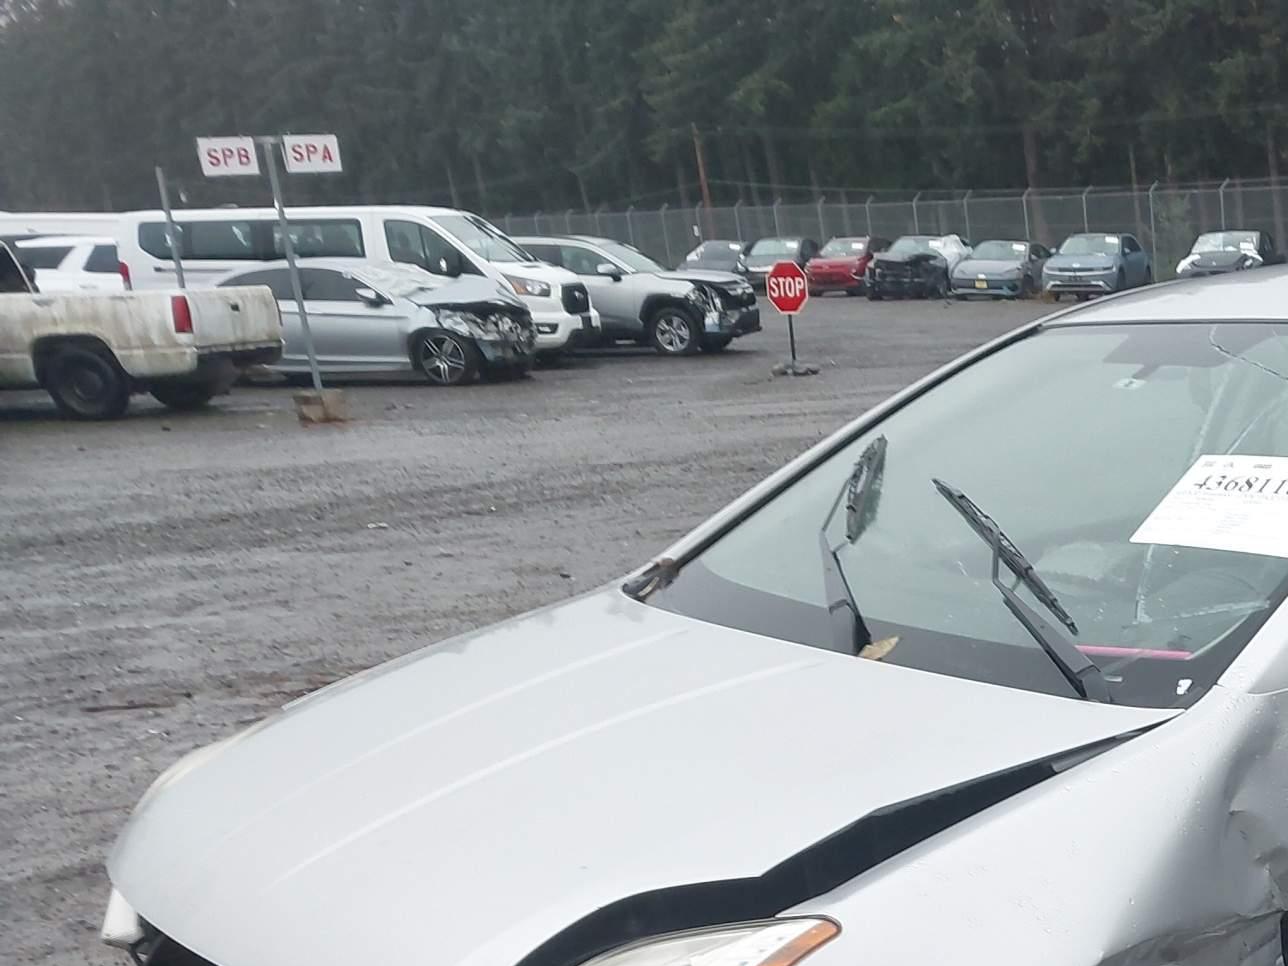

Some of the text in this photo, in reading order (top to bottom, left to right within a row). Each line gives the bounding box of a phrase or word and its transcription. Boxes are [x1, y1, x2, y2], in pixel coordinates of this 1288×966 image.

[206, 147, 251, 168] SPB
[291, 143, 334, 164] SPA
[768, 277, 804, 298] STOP
